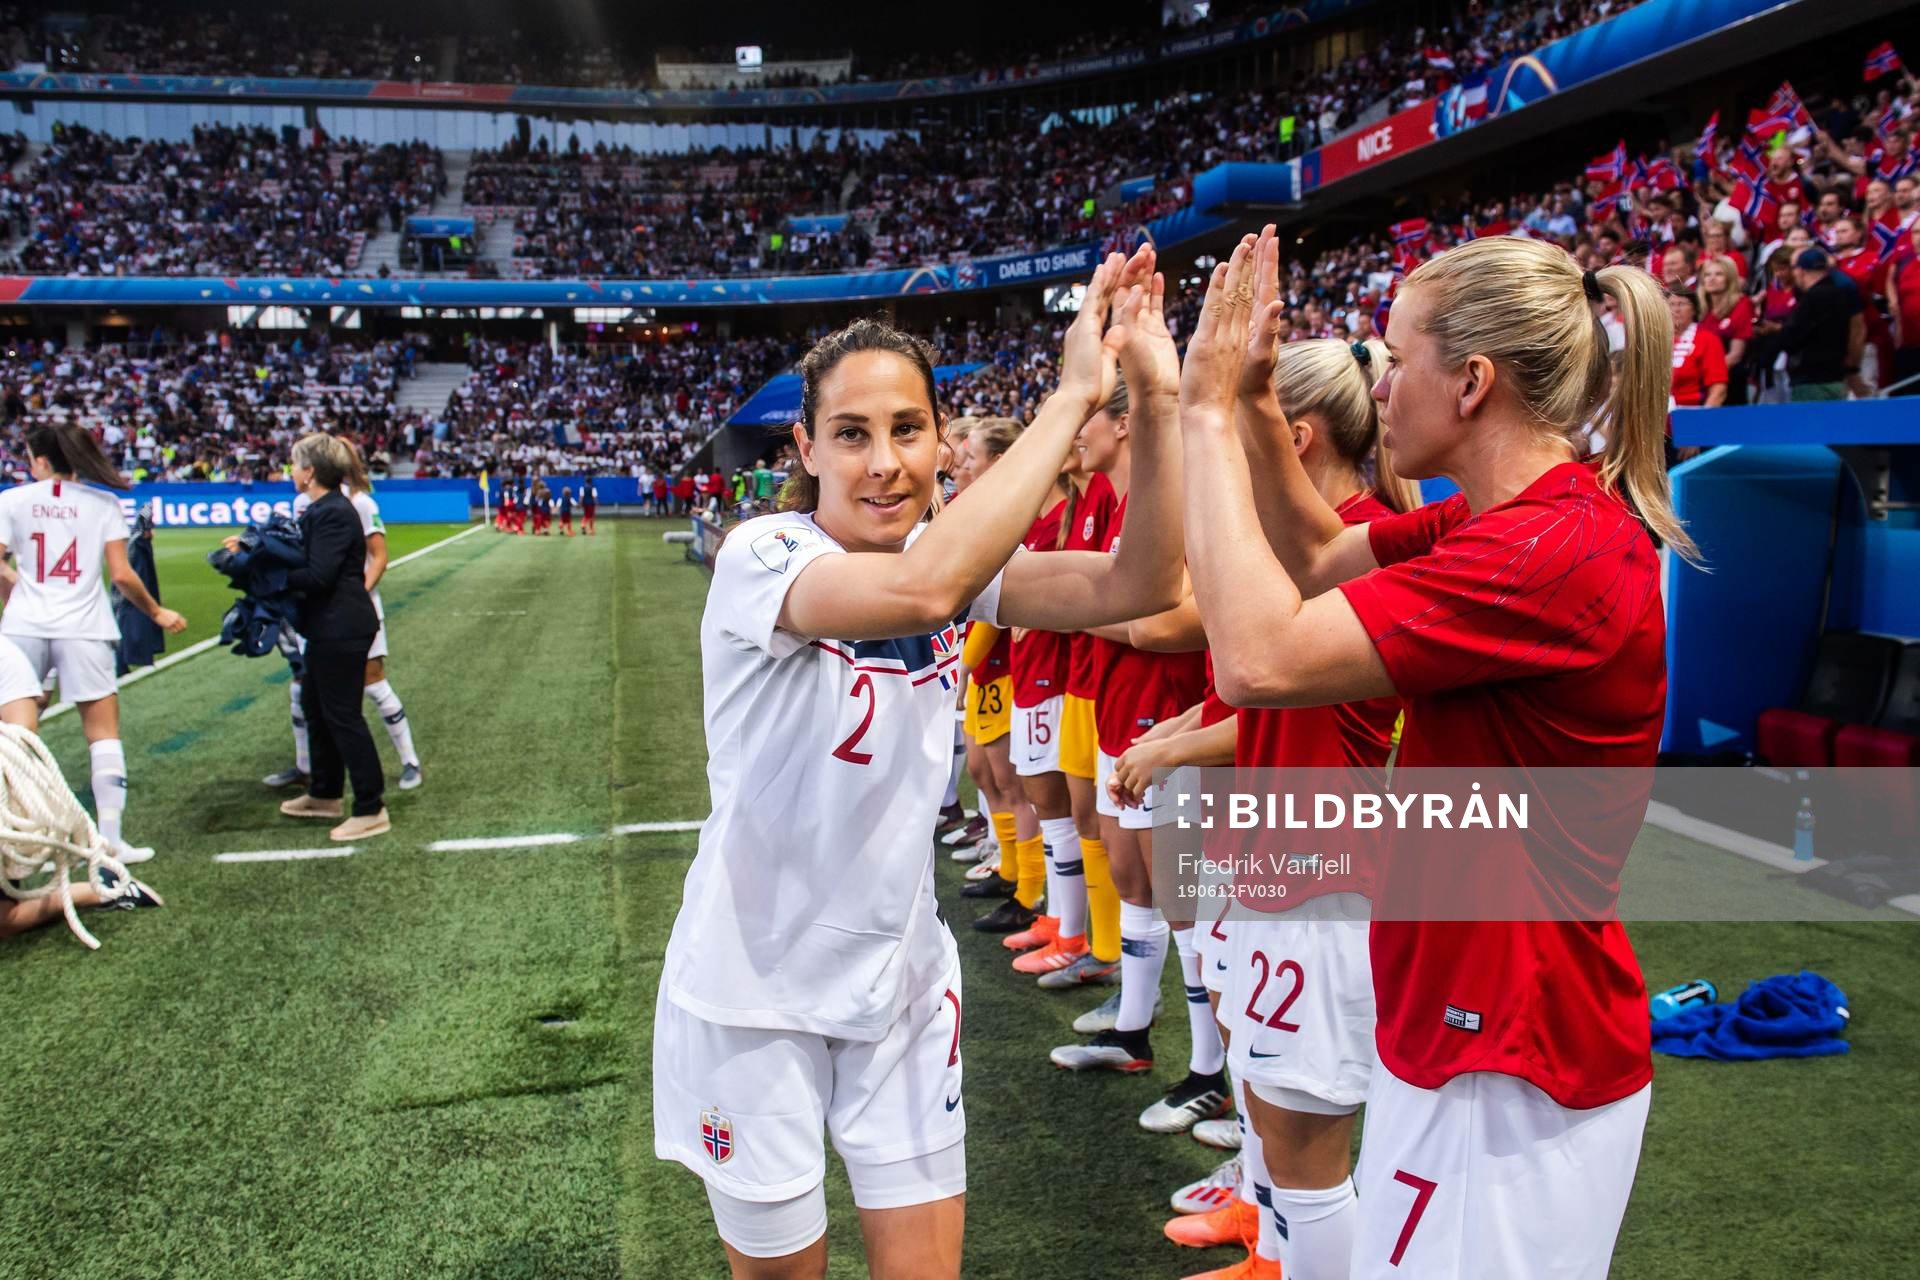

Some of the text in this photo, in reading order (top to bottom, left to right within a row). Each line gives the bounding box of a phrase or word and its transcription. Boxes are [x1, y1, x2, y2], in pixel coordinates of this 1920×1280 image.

[1357, 126, 1393, 162] NICE
[999, 250, 1087, 279] DARE TO SHINE
[31, 503, 78, 519] ENGEN
[30, 532, 82, 584] 14
[977, 684, 1003, 715] 23
[832, 673, 875, 765] 2
[1026, 711, 1052, 745] 15
[1245, 950, 1305, 1033] 22
[1389, 1169, 1438, 1267] 7
